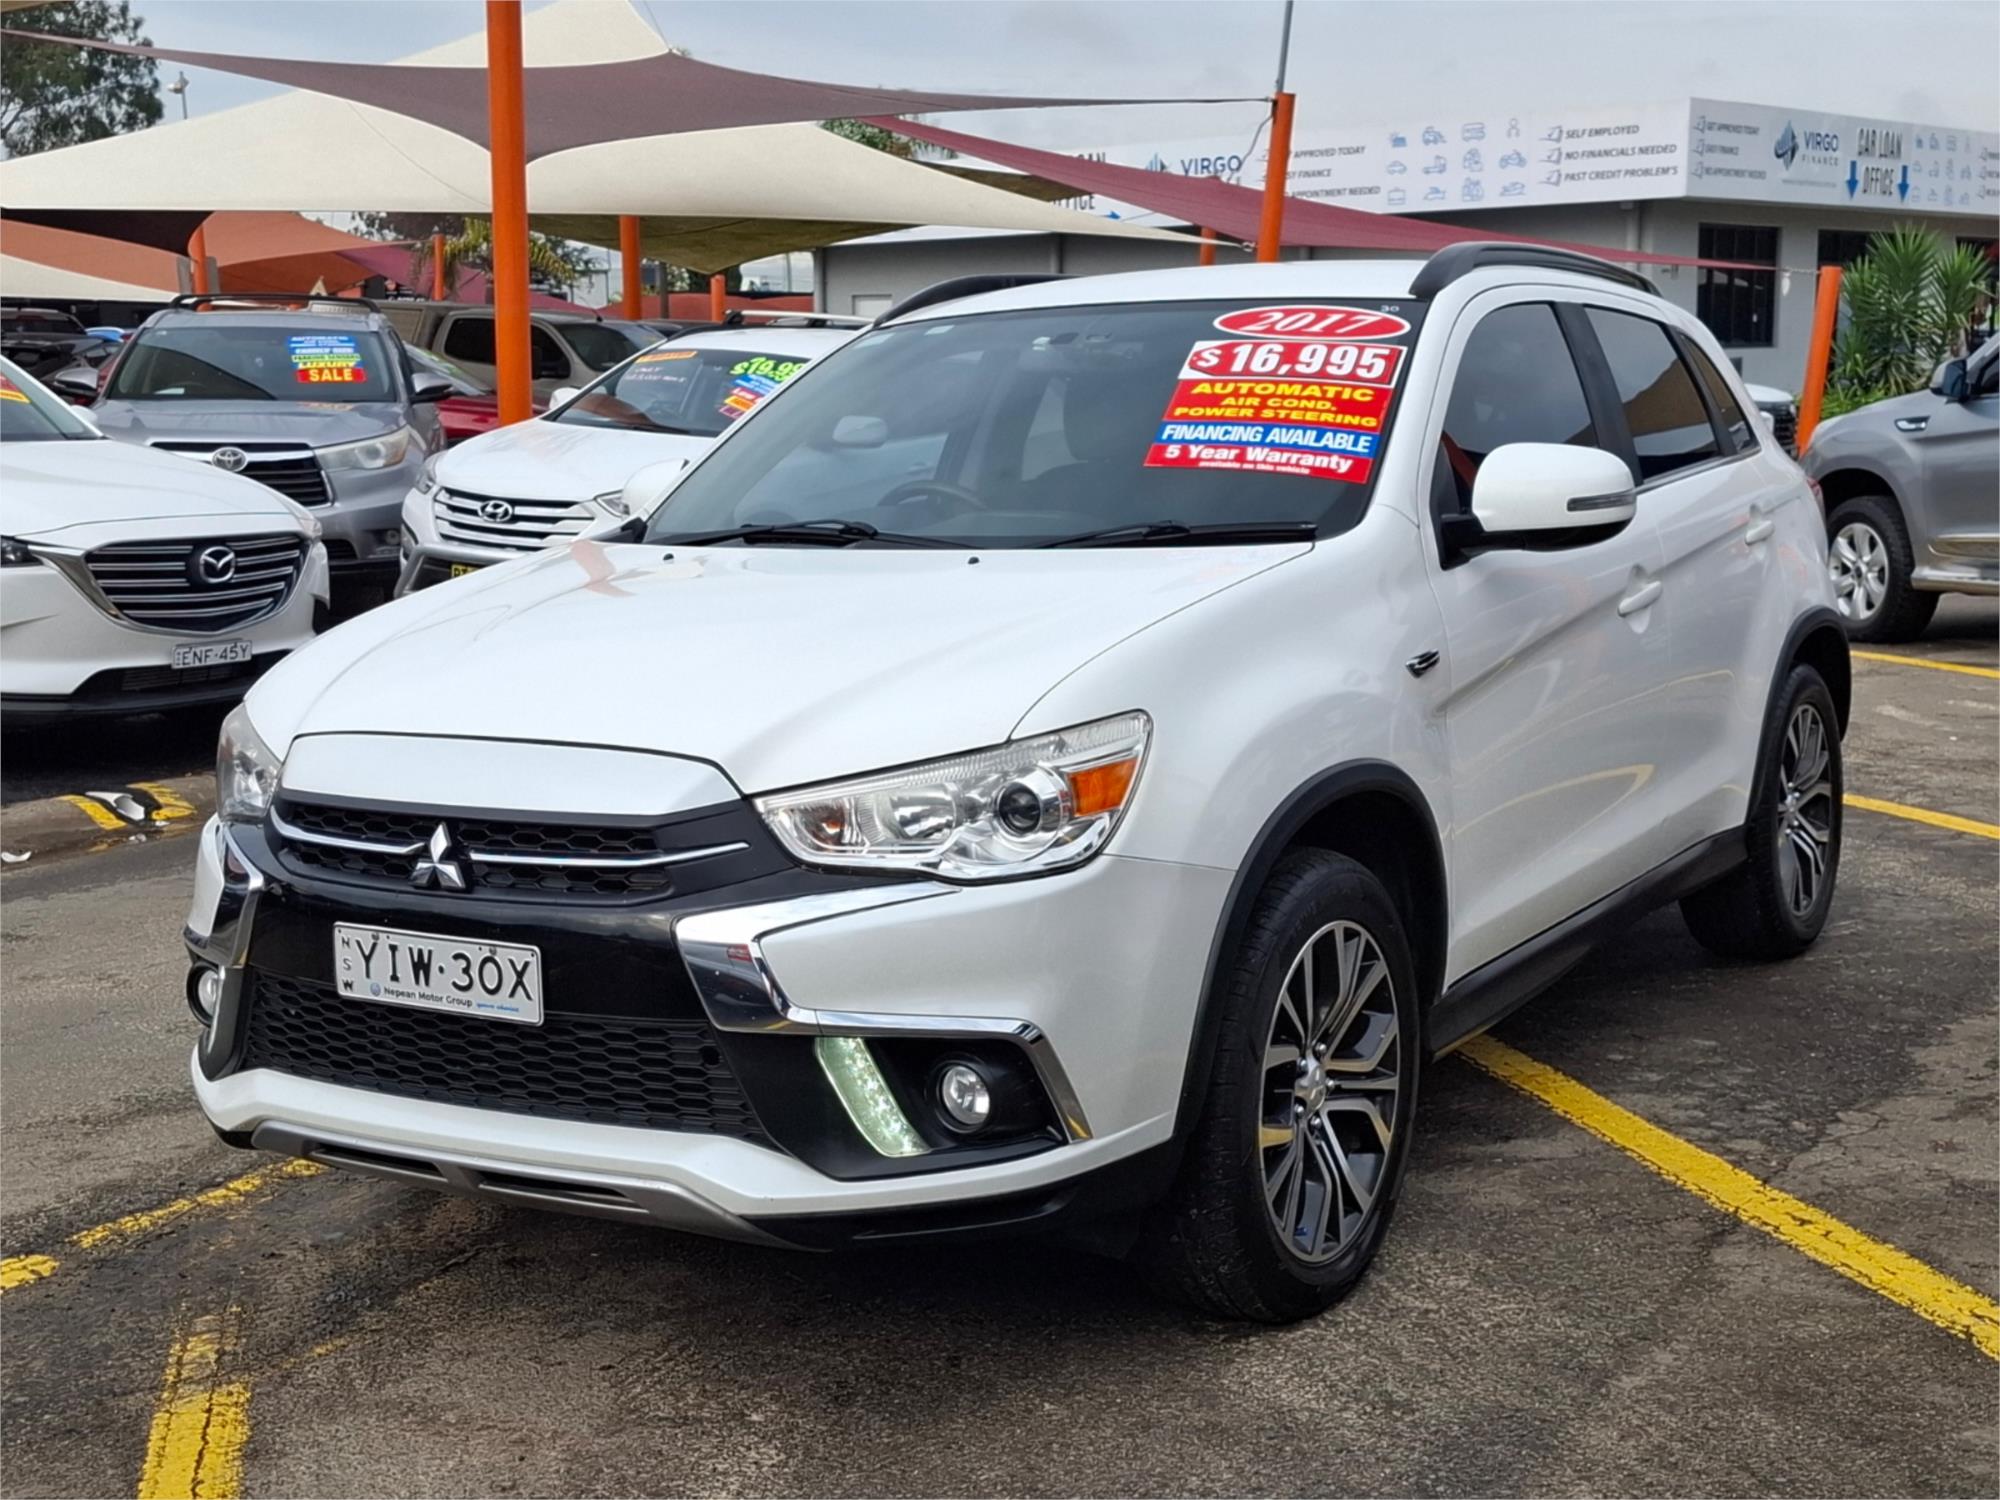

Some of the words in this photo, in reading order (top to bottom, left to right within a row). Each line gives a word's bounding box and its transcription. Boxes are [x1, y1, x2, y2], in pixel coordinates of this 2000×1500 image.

[1565, 128, 1586, 139] SELF
[1588, 125, 1640, 137] EMPLOYED
[1803, 130, 1839, 152] VIRGO
[1564, 149, 1579, 160] NO
[1580, 147, 1636, 159] FINANCIALS
[1637, 144, 1678, 155] NEEDED
[1858, 128, 1876, 156] CAR
[1878, 130, 1902, 158] LOAN
[1180, 155, 1243, 176] VIRGO
[1802, 154, 1839, 166] FINANCE
[1564, 172, 1586, 182] PAST
[1588, 170, 1622, 181] CREDIT
[1623, 166, 1678, 178] PROBLEM'S
[1862, 166, 1894, 196] OFFICE
[1239, 311, 1381, 333] 2017
[1230, 344, 1390, 379] 16,995
[309, 368, 354, 382] SALE
[1191, 382, 1375, 402] AUTOMATIC
[1221, 396, 1262, 407] AIR
[1267, 398, 1337, 411] COND.
[1174, 407, 1254, 418] POWER
[1260, 409, 1378, 427] STEERING
[1161, 424, 1263, 443] FINANCING
[1265, 428, 1372, 453] AVAILABLE
[1165, 445, 1181, 459] 5
[1188, 445, 1239, 462] Year
[1245, 447, 1354, 473] Warranty
[383, 986, 417, 1000] Nepean
[418, 991, 444, 1003] Motor
[445, 995, 473, 1008] Group
